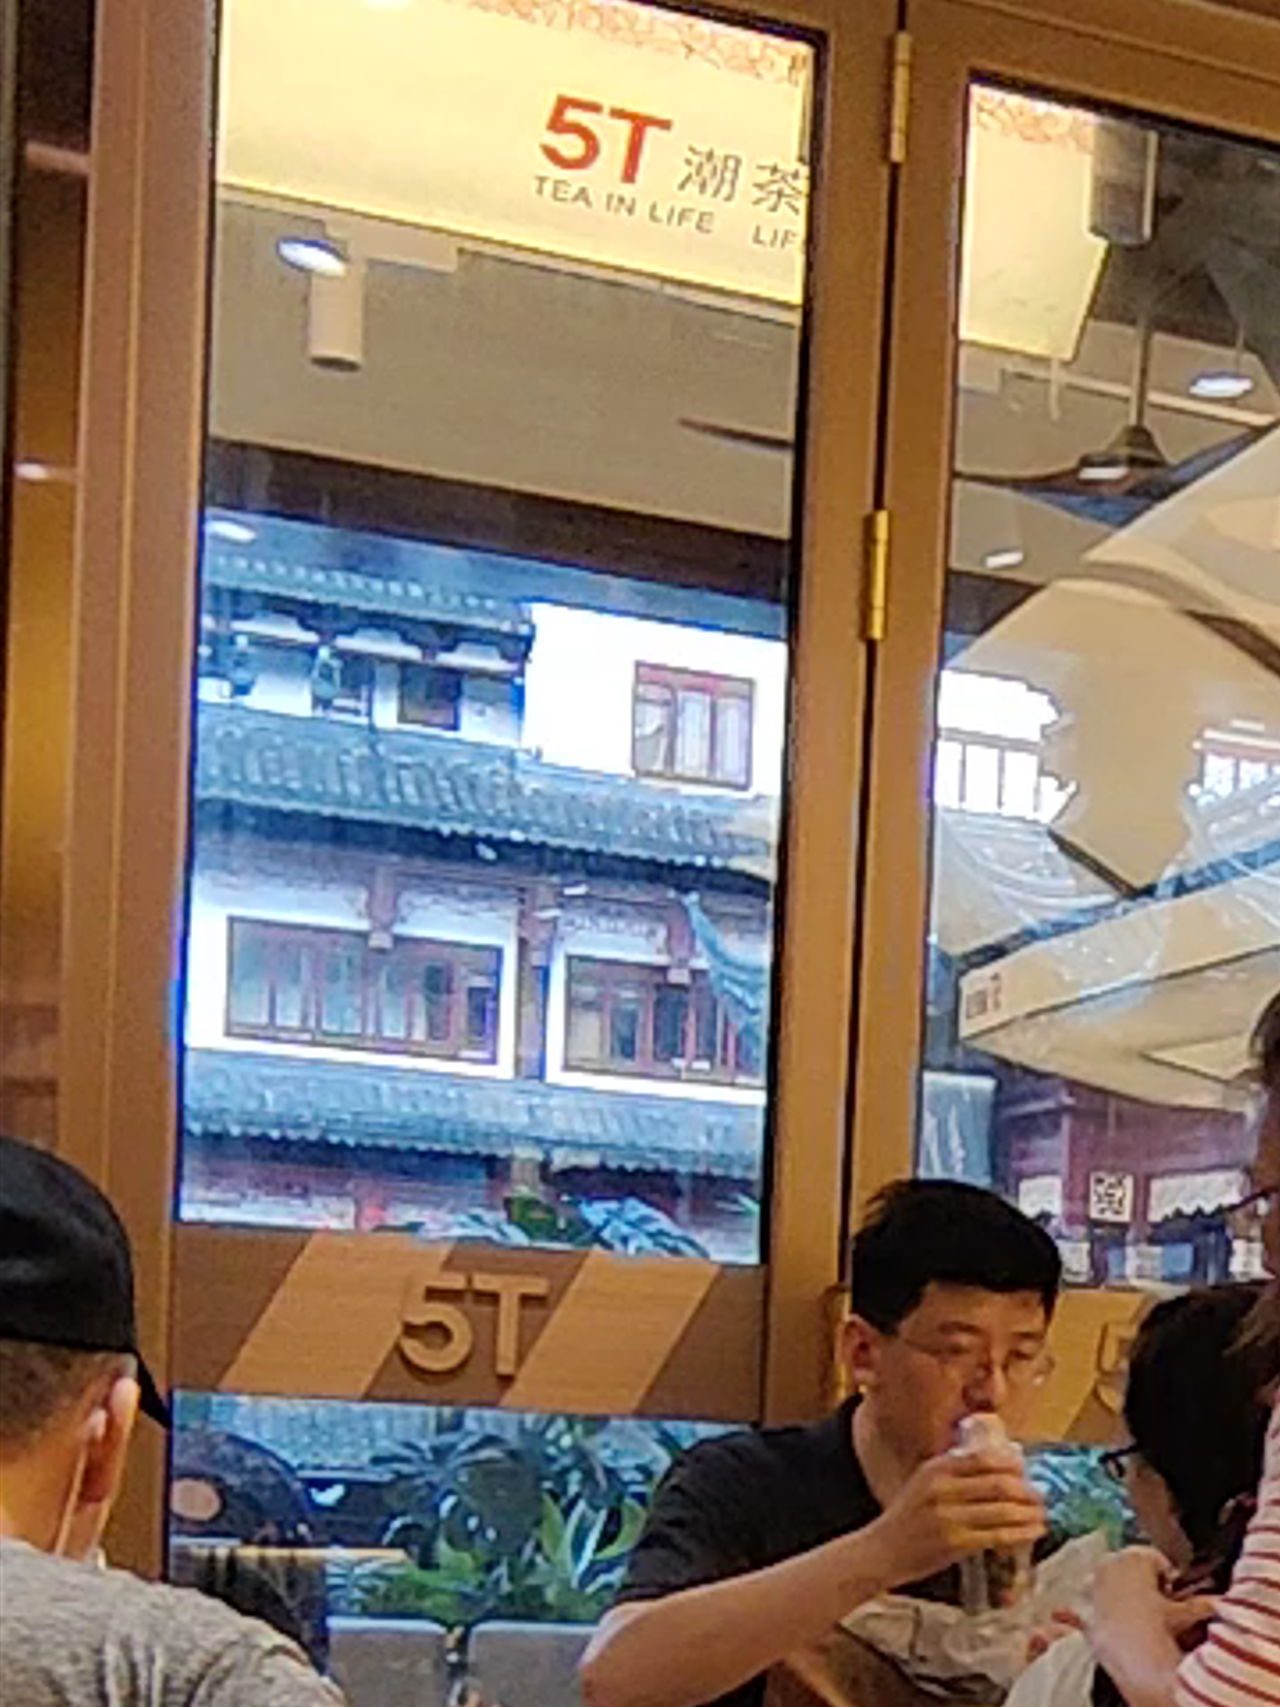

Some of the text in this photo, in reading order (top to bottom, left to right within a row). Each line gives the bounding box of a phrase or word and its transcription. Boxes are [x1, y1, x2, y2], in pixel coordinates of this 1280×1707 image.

[540, 94, 673, 184] 5T
[534, 175, 800, 249] TEA IN LIFE LIF
[399, 1270, 549, 1374] 5T
